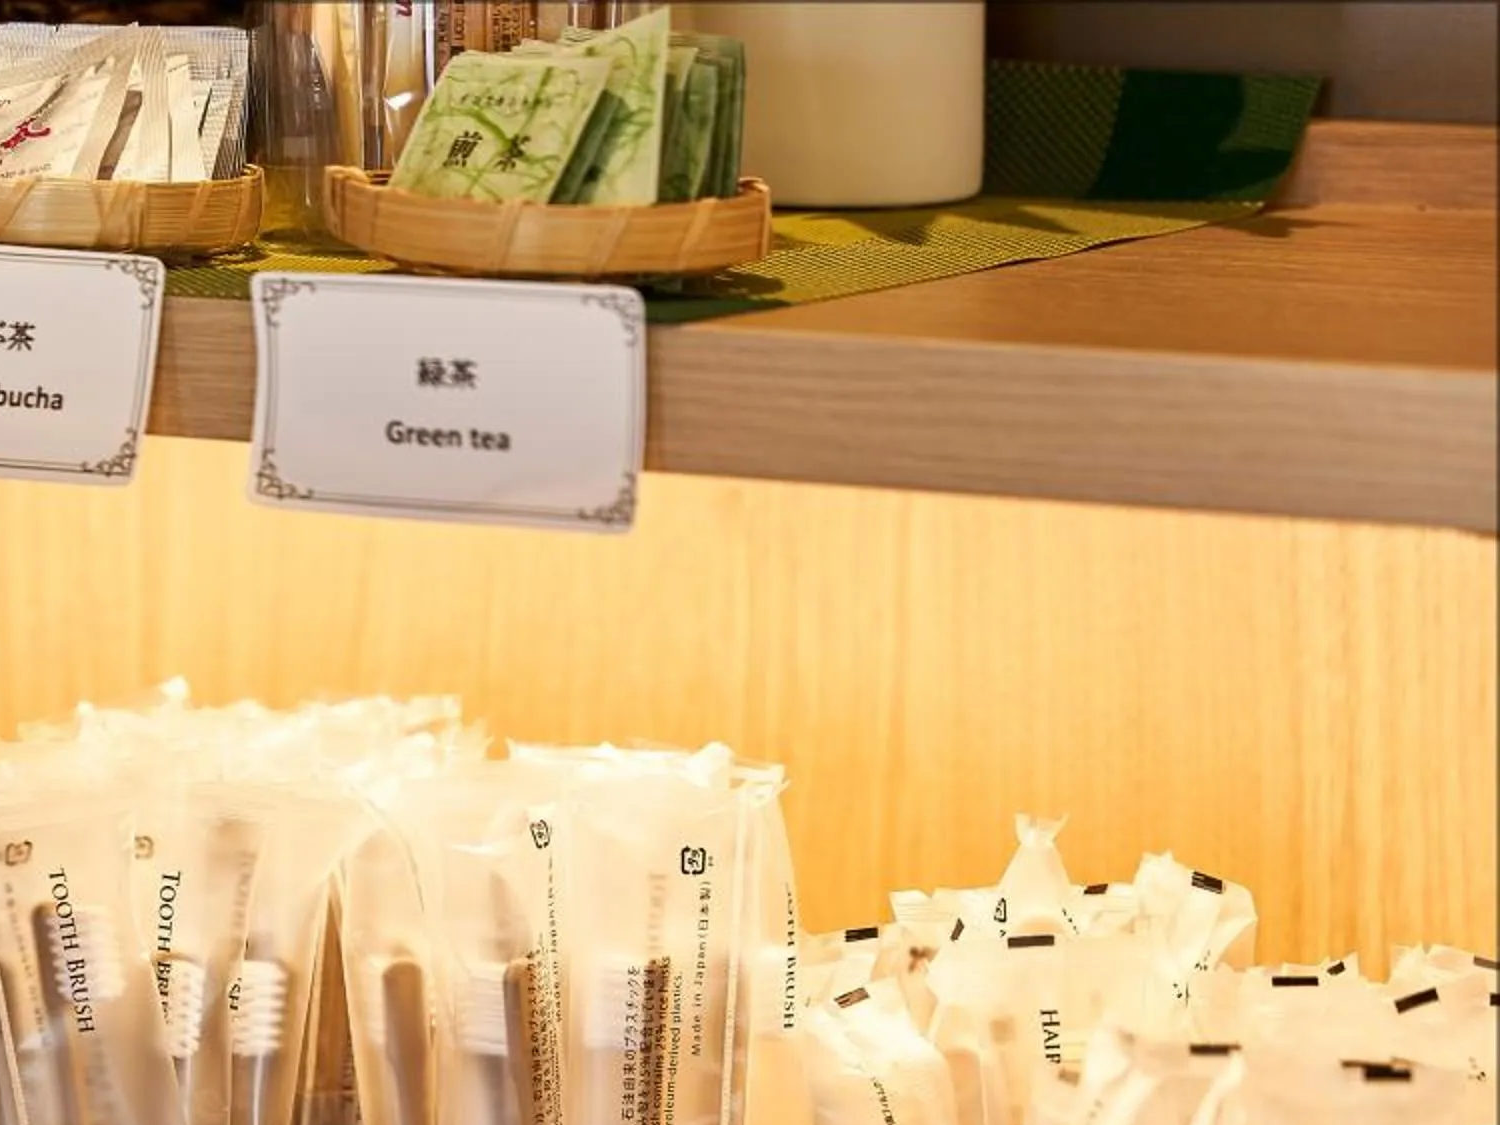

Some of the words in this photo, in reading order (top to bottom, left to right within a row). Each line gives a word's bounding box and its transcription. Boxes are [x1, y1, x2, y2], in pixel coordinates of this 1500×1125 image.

[443, 130, 531, 172] 煎茶
[417, 357, 478, 388] 緑茶
[385, 420, 462, 447] Green
[470, 428, 512, 451] tea
[158, 871, 182, 952] TOOTH
[49, 868, 80, 950] TOOTH
[66, 958, 95, 1033] BRUSH
[693, 993, 702, 1008] in
[691, 1015, 701, 1057] Made
[653, 1055, 664, 1109] contains
